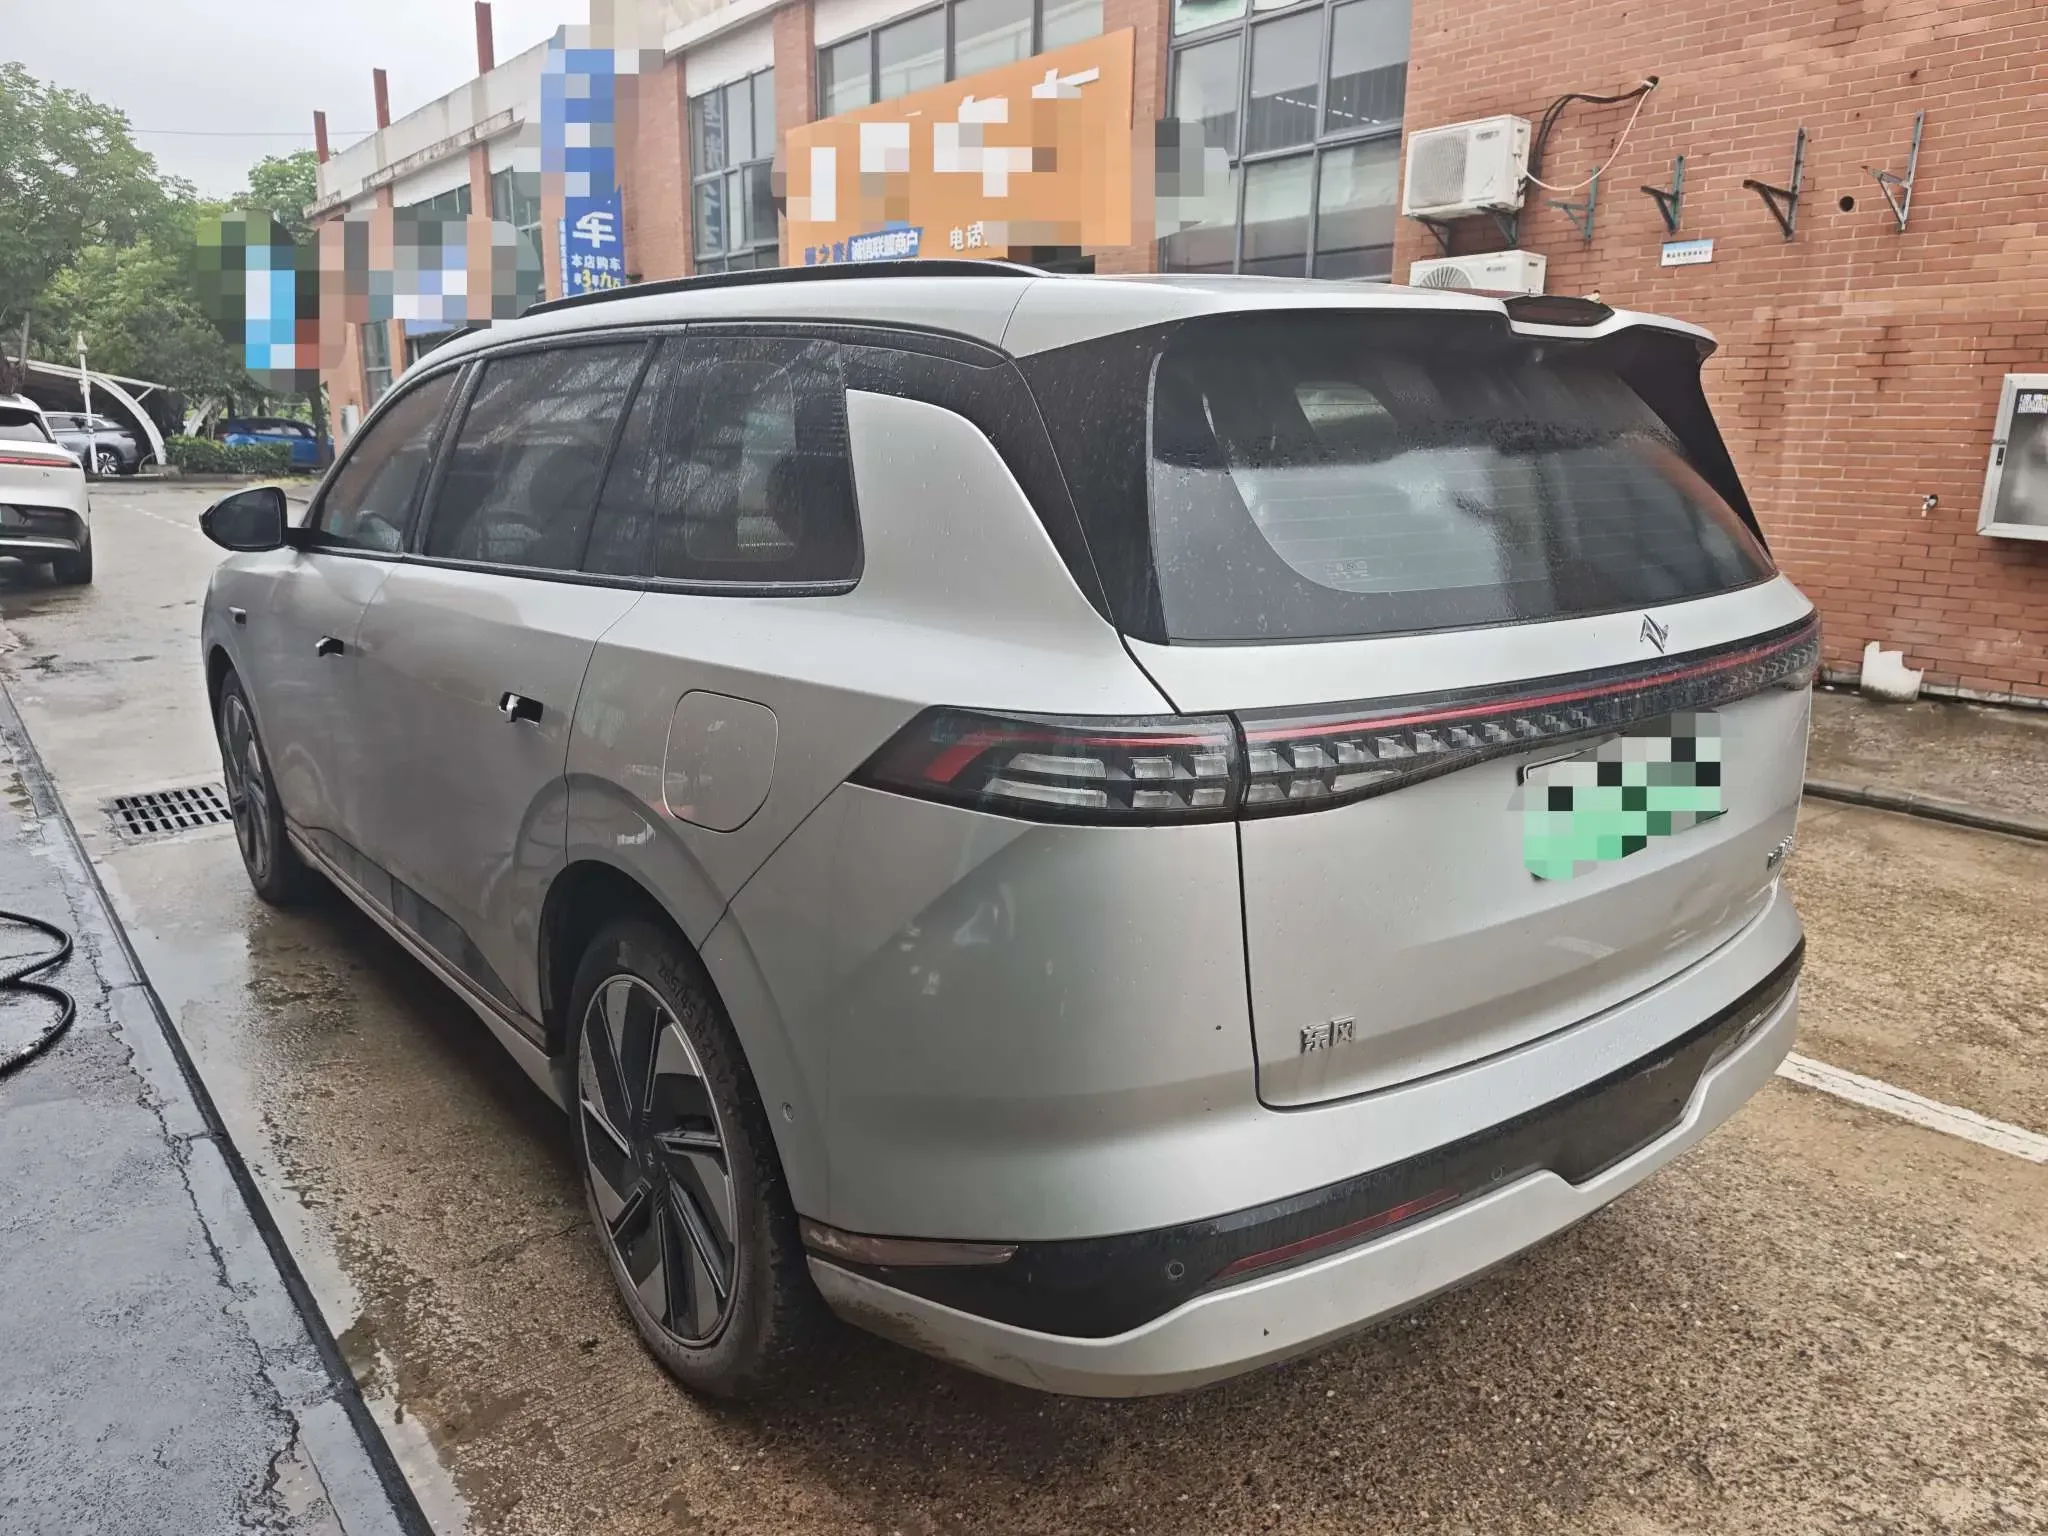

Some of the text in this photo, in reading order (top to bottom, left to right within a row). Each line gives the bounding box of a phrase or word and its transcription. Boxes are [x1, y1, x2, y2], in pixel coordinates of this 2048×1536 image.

[572, 211, 616, 248] 车
[571, 253, 621, 271] 本店购车
[1300, 1016, 1356, 1054] 东风
